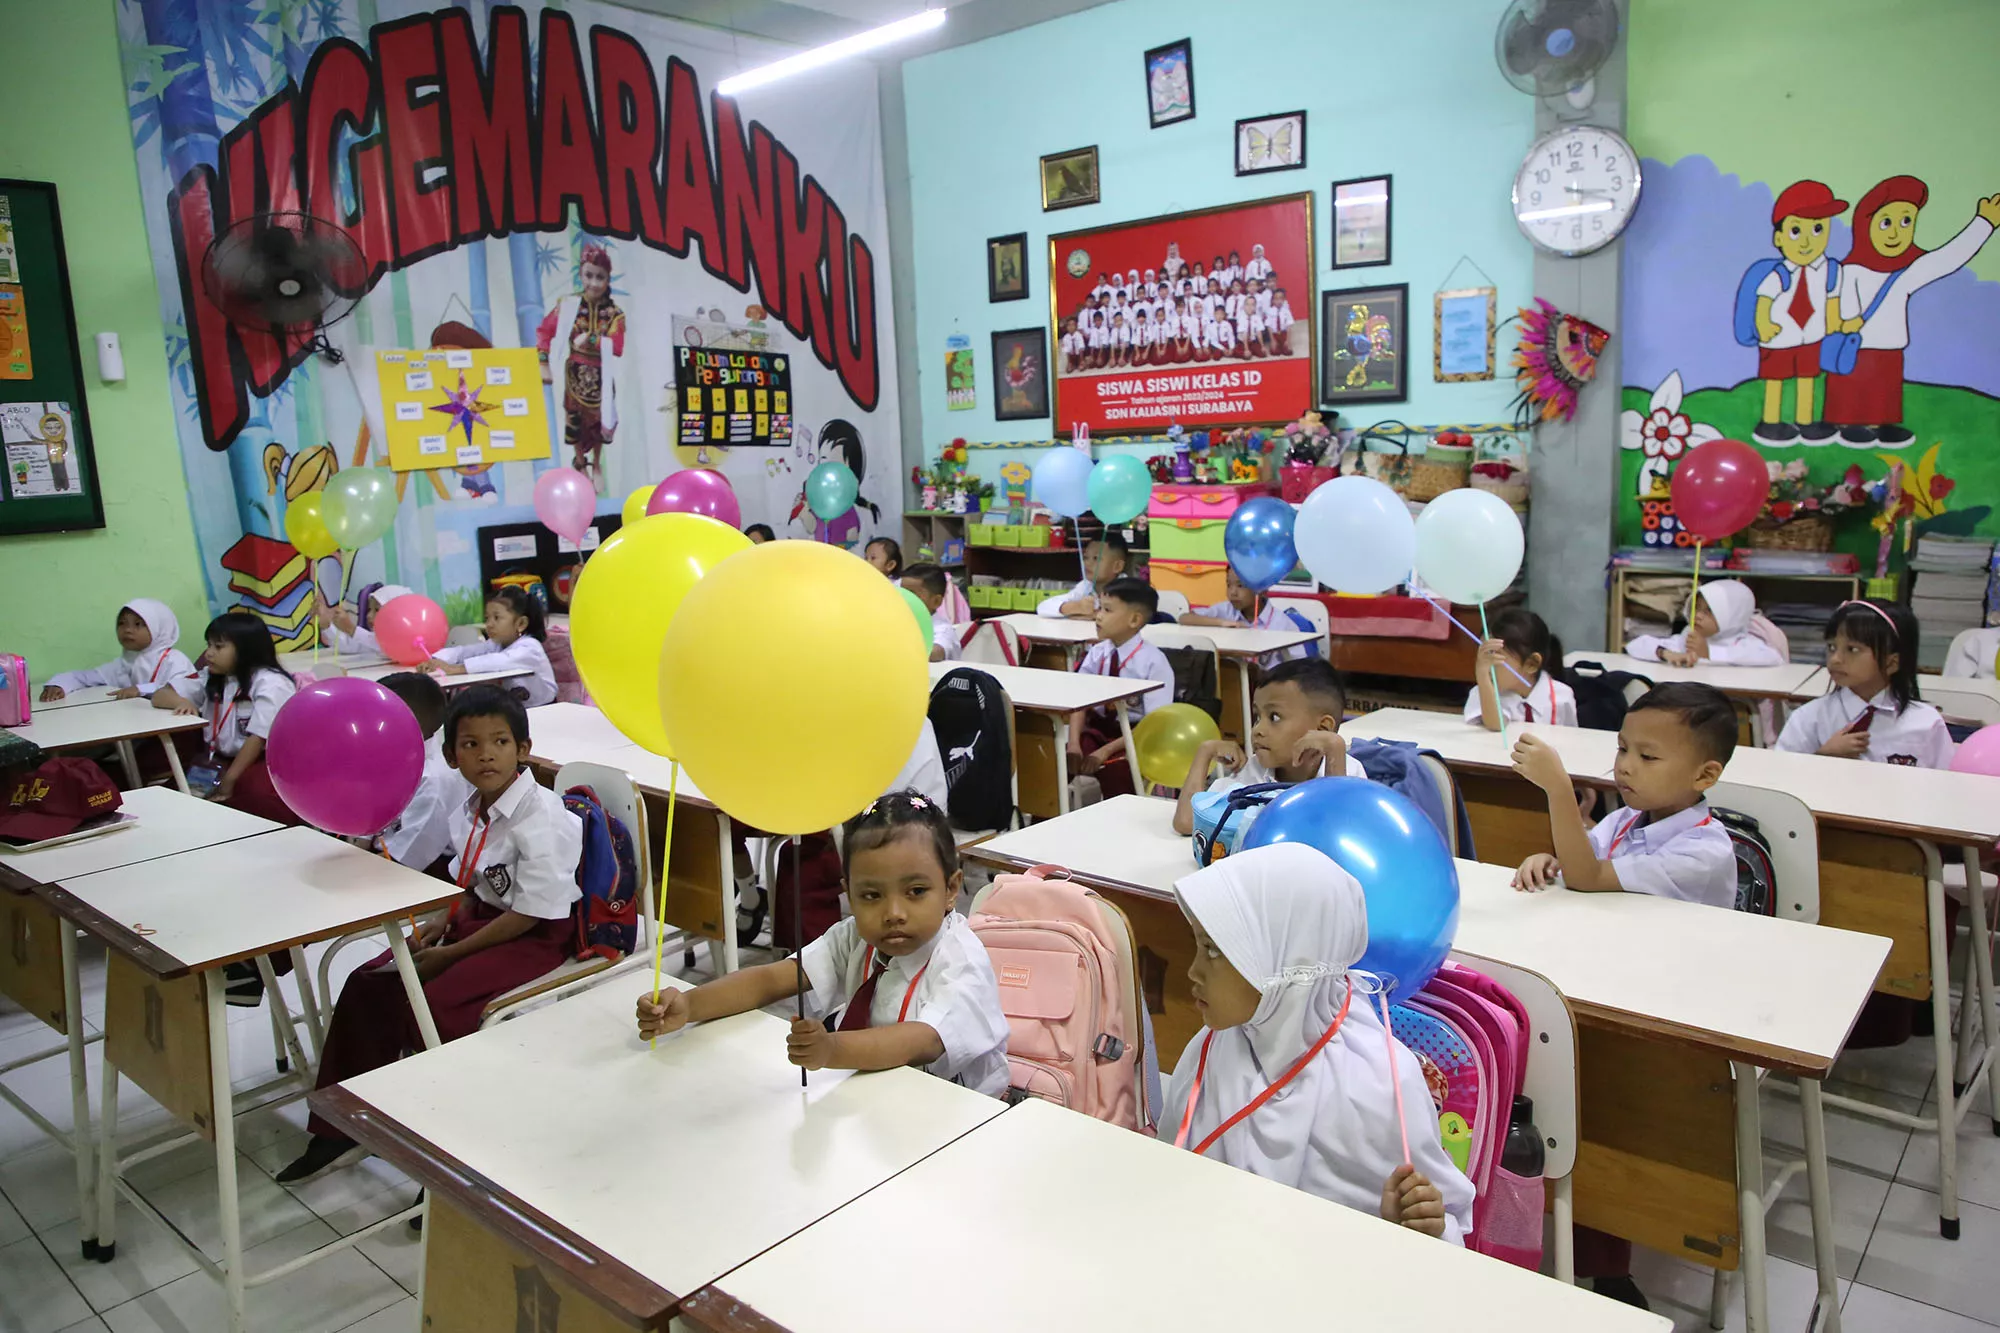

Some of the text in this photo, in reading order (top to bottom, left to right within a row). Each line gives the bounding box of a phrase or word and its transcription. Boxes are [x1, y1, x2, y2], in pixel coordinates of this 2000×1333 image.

[1566, 141, 1584, 158] 12
[1592, 144, 1599, 159] 1
[1549, 151, 1561, 167] 11
[1605, 156, 1616, 172] 2
[1534, 168, 1551, 185] 10
[1611, 176, 1622, 192] 3
[1530, 191, 1541, 206] 9
[1097, 370, 1262, 396] SISWA SISWI KELAS 1D
[1105, 400, 1253, 420] SDN KALIASIN I SURABAYA
